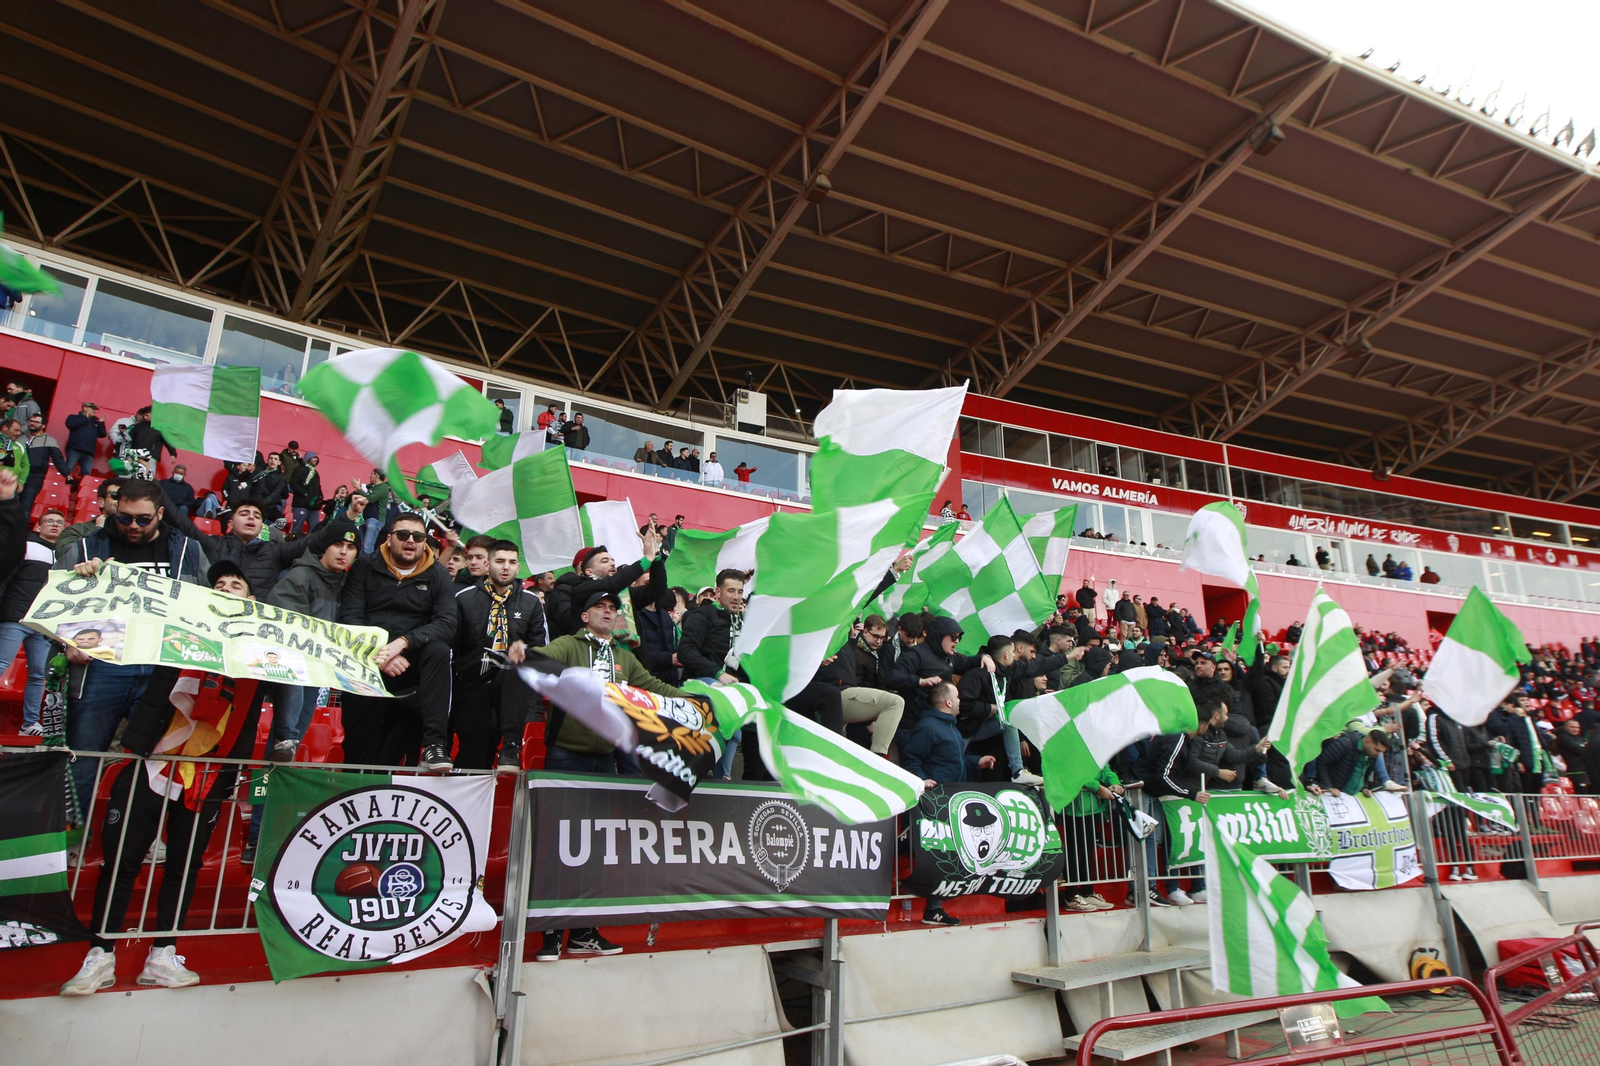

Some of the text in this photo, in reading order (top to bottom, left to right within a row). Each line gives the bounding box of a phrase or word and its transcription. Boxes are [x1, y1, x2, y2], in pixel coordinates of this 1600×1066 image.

[1052, 478, 1158, 505] VAMOS ALMERÍA
[1288, 514, 1335, 533] ALMERÍA
[1338, 519, 1370, 537] NUNCA
[1371, 527, 1388, 539] SE
[1481, 542, 1579, 566] UNIÓN
[31, 592, 168, 619] DAME
[179, 616, 212, 632] LA
[217, 620, 385, 691] CAMISETA
[208, 591, 379, 666] JUANMI
[299, 795, 463, 850] FANATICOS
[753, 807, 804, 838] SOCIEDAD SEVILLA
[342, 833, 424, 861] JVTD
[558, 819, 746, 867] UTRERA
[765, 833, 794, 851] Balompié
[812, 827, 883, 871] FANS
[287, 880, 300, 889] 20
[988, 876, 1042, 895] TOUR
[348, 897, 416, 925] 1907
[299, 898, 464, 960] REAL BETIS
